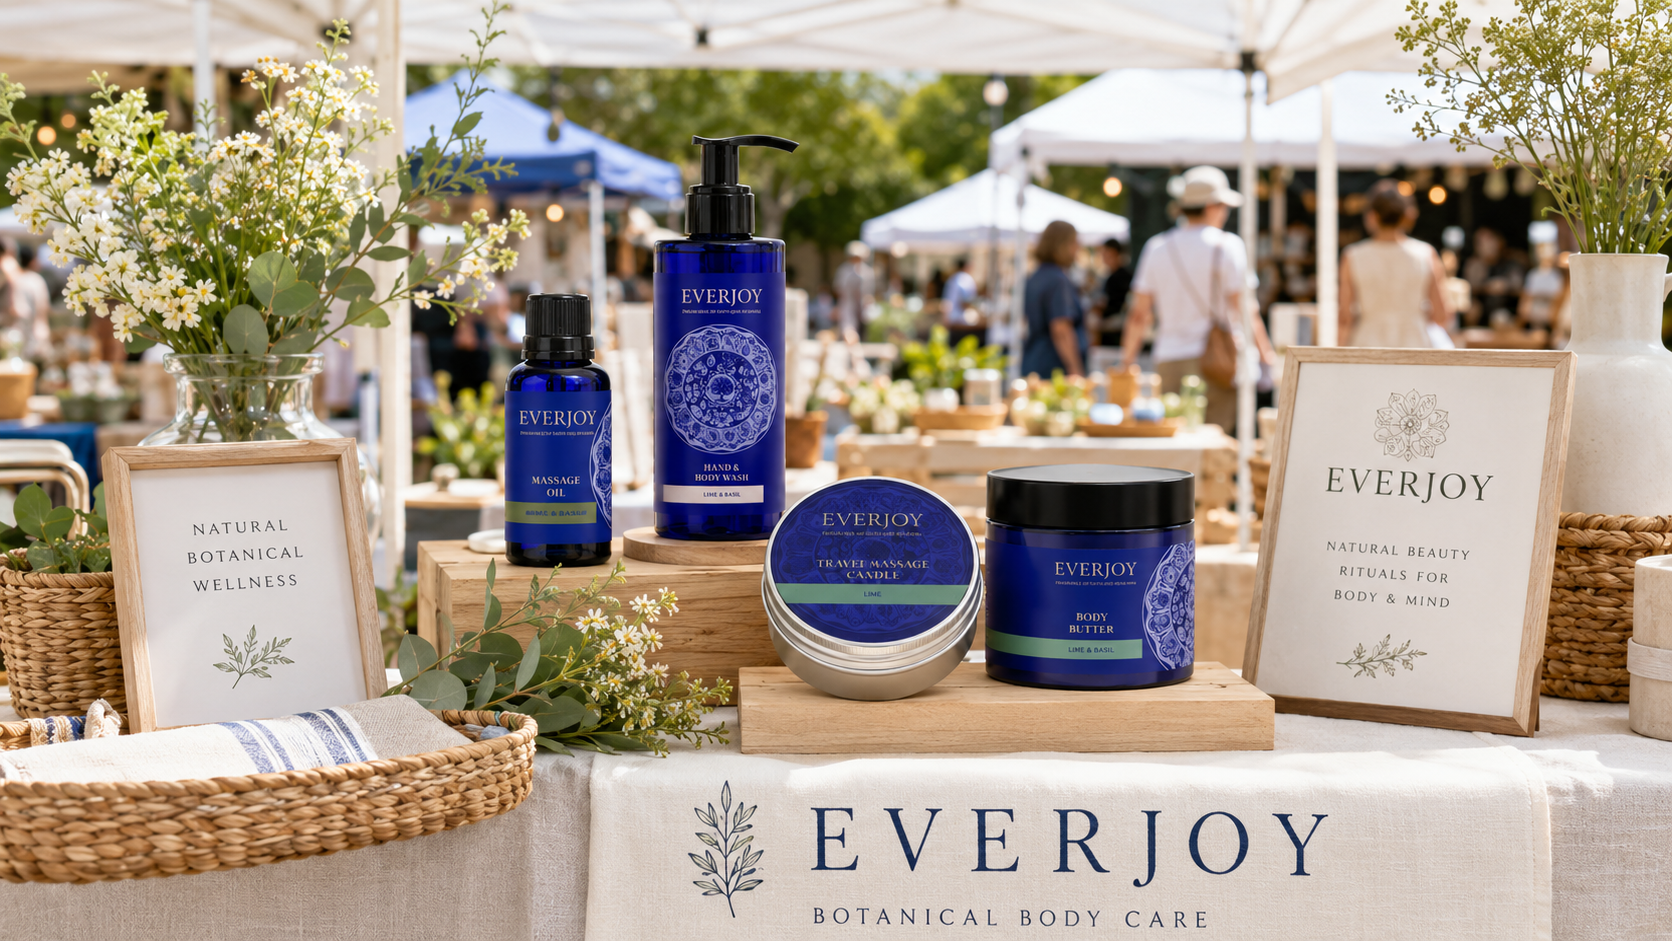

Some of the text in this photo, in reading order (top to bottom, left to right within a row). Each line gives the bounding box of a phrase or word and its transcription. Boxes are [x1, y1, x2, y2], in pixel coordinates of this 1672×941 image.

[681, 288, 763, 307] EVERJOY
[519, 410, 597, 428] EVERJOY
[703, 464, 740, 472] HAND &
[531, 476, 580, 485] MASSAGE
[695, 473, 749, 482] BODY WASH
[1326, 466, 1494, 504] EVERJOY
[546, 488, 566, 497] OIL
[193, 519, 288, 536] NATURAL
[822, 512, 923, 530] EVERJOY
[187, 546, 304, 565] BOTANICAL
[1326, 541, 1470, 561] NATURAL BEAUTY
[869, 560, 930, 569] MASSAGE
[1055, 561, 1137, 579] EVERJOY
[193, 574, 298, 593] WELLNESS
[846, 571, 900, 580] CANDLE
[1339, 566, 1449, 584] RITUALS FOR
[1334, 589, 1451, 608] BODY & MIND
[1076, 612, 1109, 622] BODY
[1069, 625, 1114, 634] BUTTER
[810, 806, 1329, 888] EVERJOY
[813, 907, 1209, 929] BOTANICAL BODY CARE
